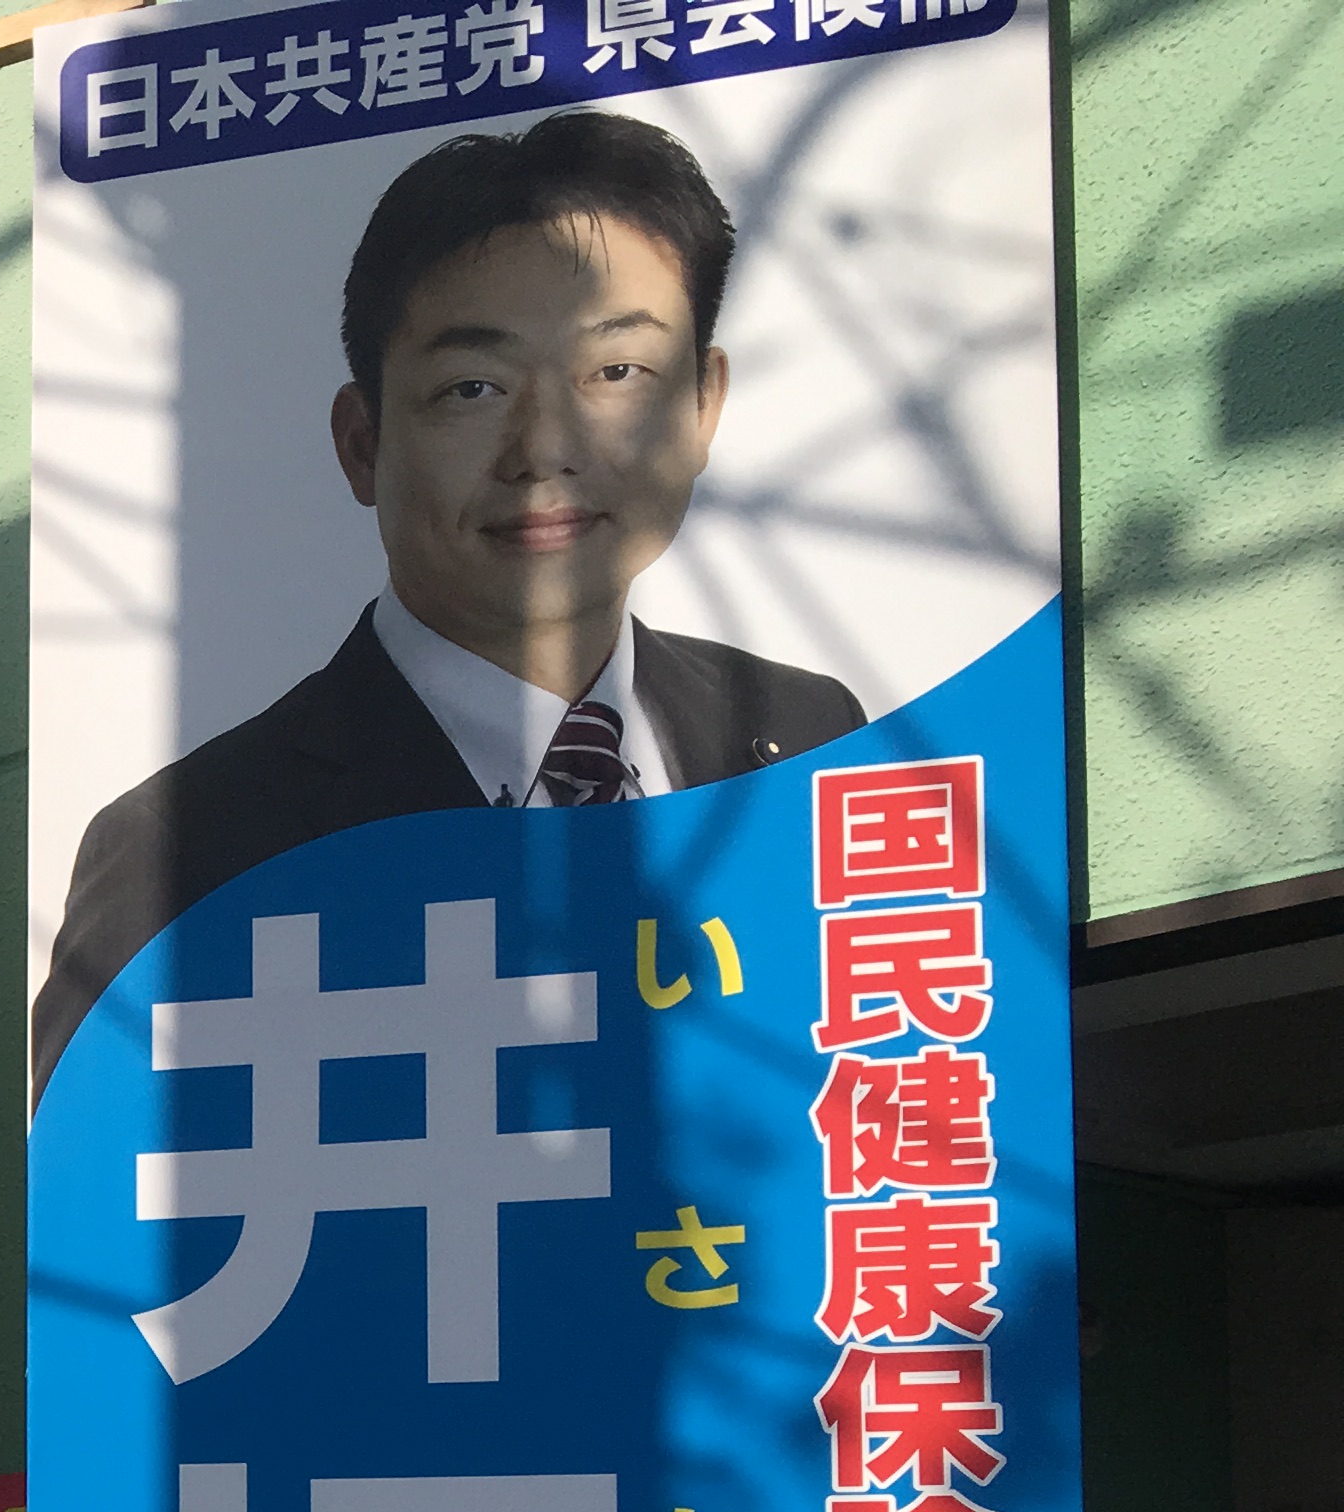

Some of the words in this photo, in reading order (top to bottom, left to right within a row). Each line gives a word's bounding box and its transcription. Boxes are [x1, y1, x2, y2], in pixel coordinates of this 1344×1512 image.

[86, 2, 546, 158] 日本共産党
